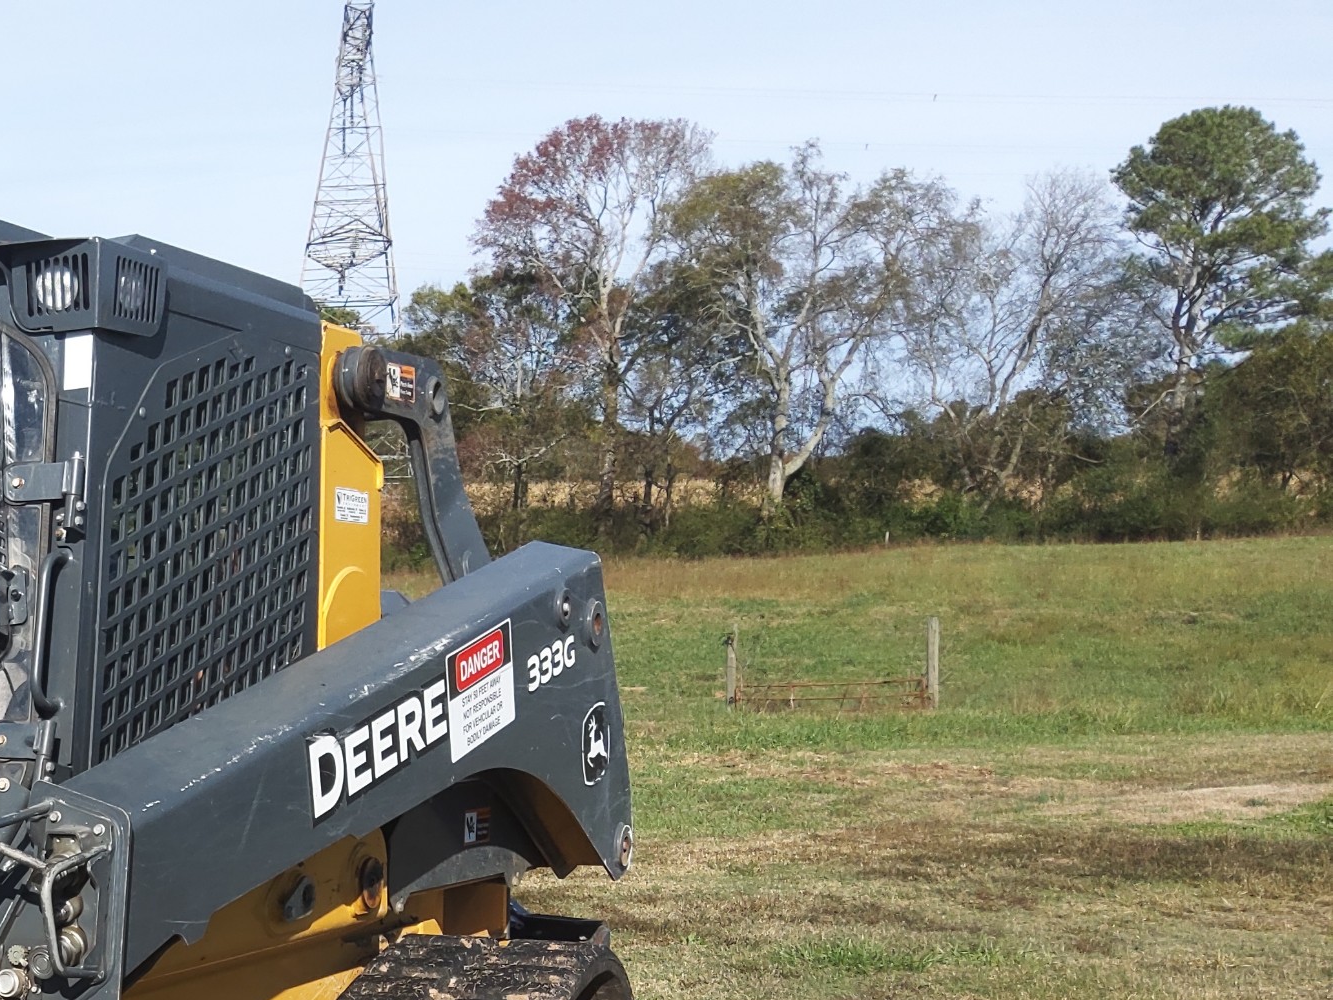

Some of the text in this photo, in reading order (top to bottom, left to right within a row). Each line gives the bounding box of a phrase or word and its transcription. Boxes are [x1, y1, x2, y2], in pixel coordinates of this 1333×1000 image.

[460, 640, 501, 682] DANGER
[527, 634, 576, 692] 333G
[462, 692, 473, 708] STAY
[479, 681, 489, 696] FEET
[490, 675, 501, 689] AWAY
[463, 688, 501, 720] NOT RESPONSIBLE
[463, 700, 503, 735] FOR VEHICULAR OR
[467, 716, 501, 746] BODILY DAMAGE
[308, 678, 449, 819] DEERE
